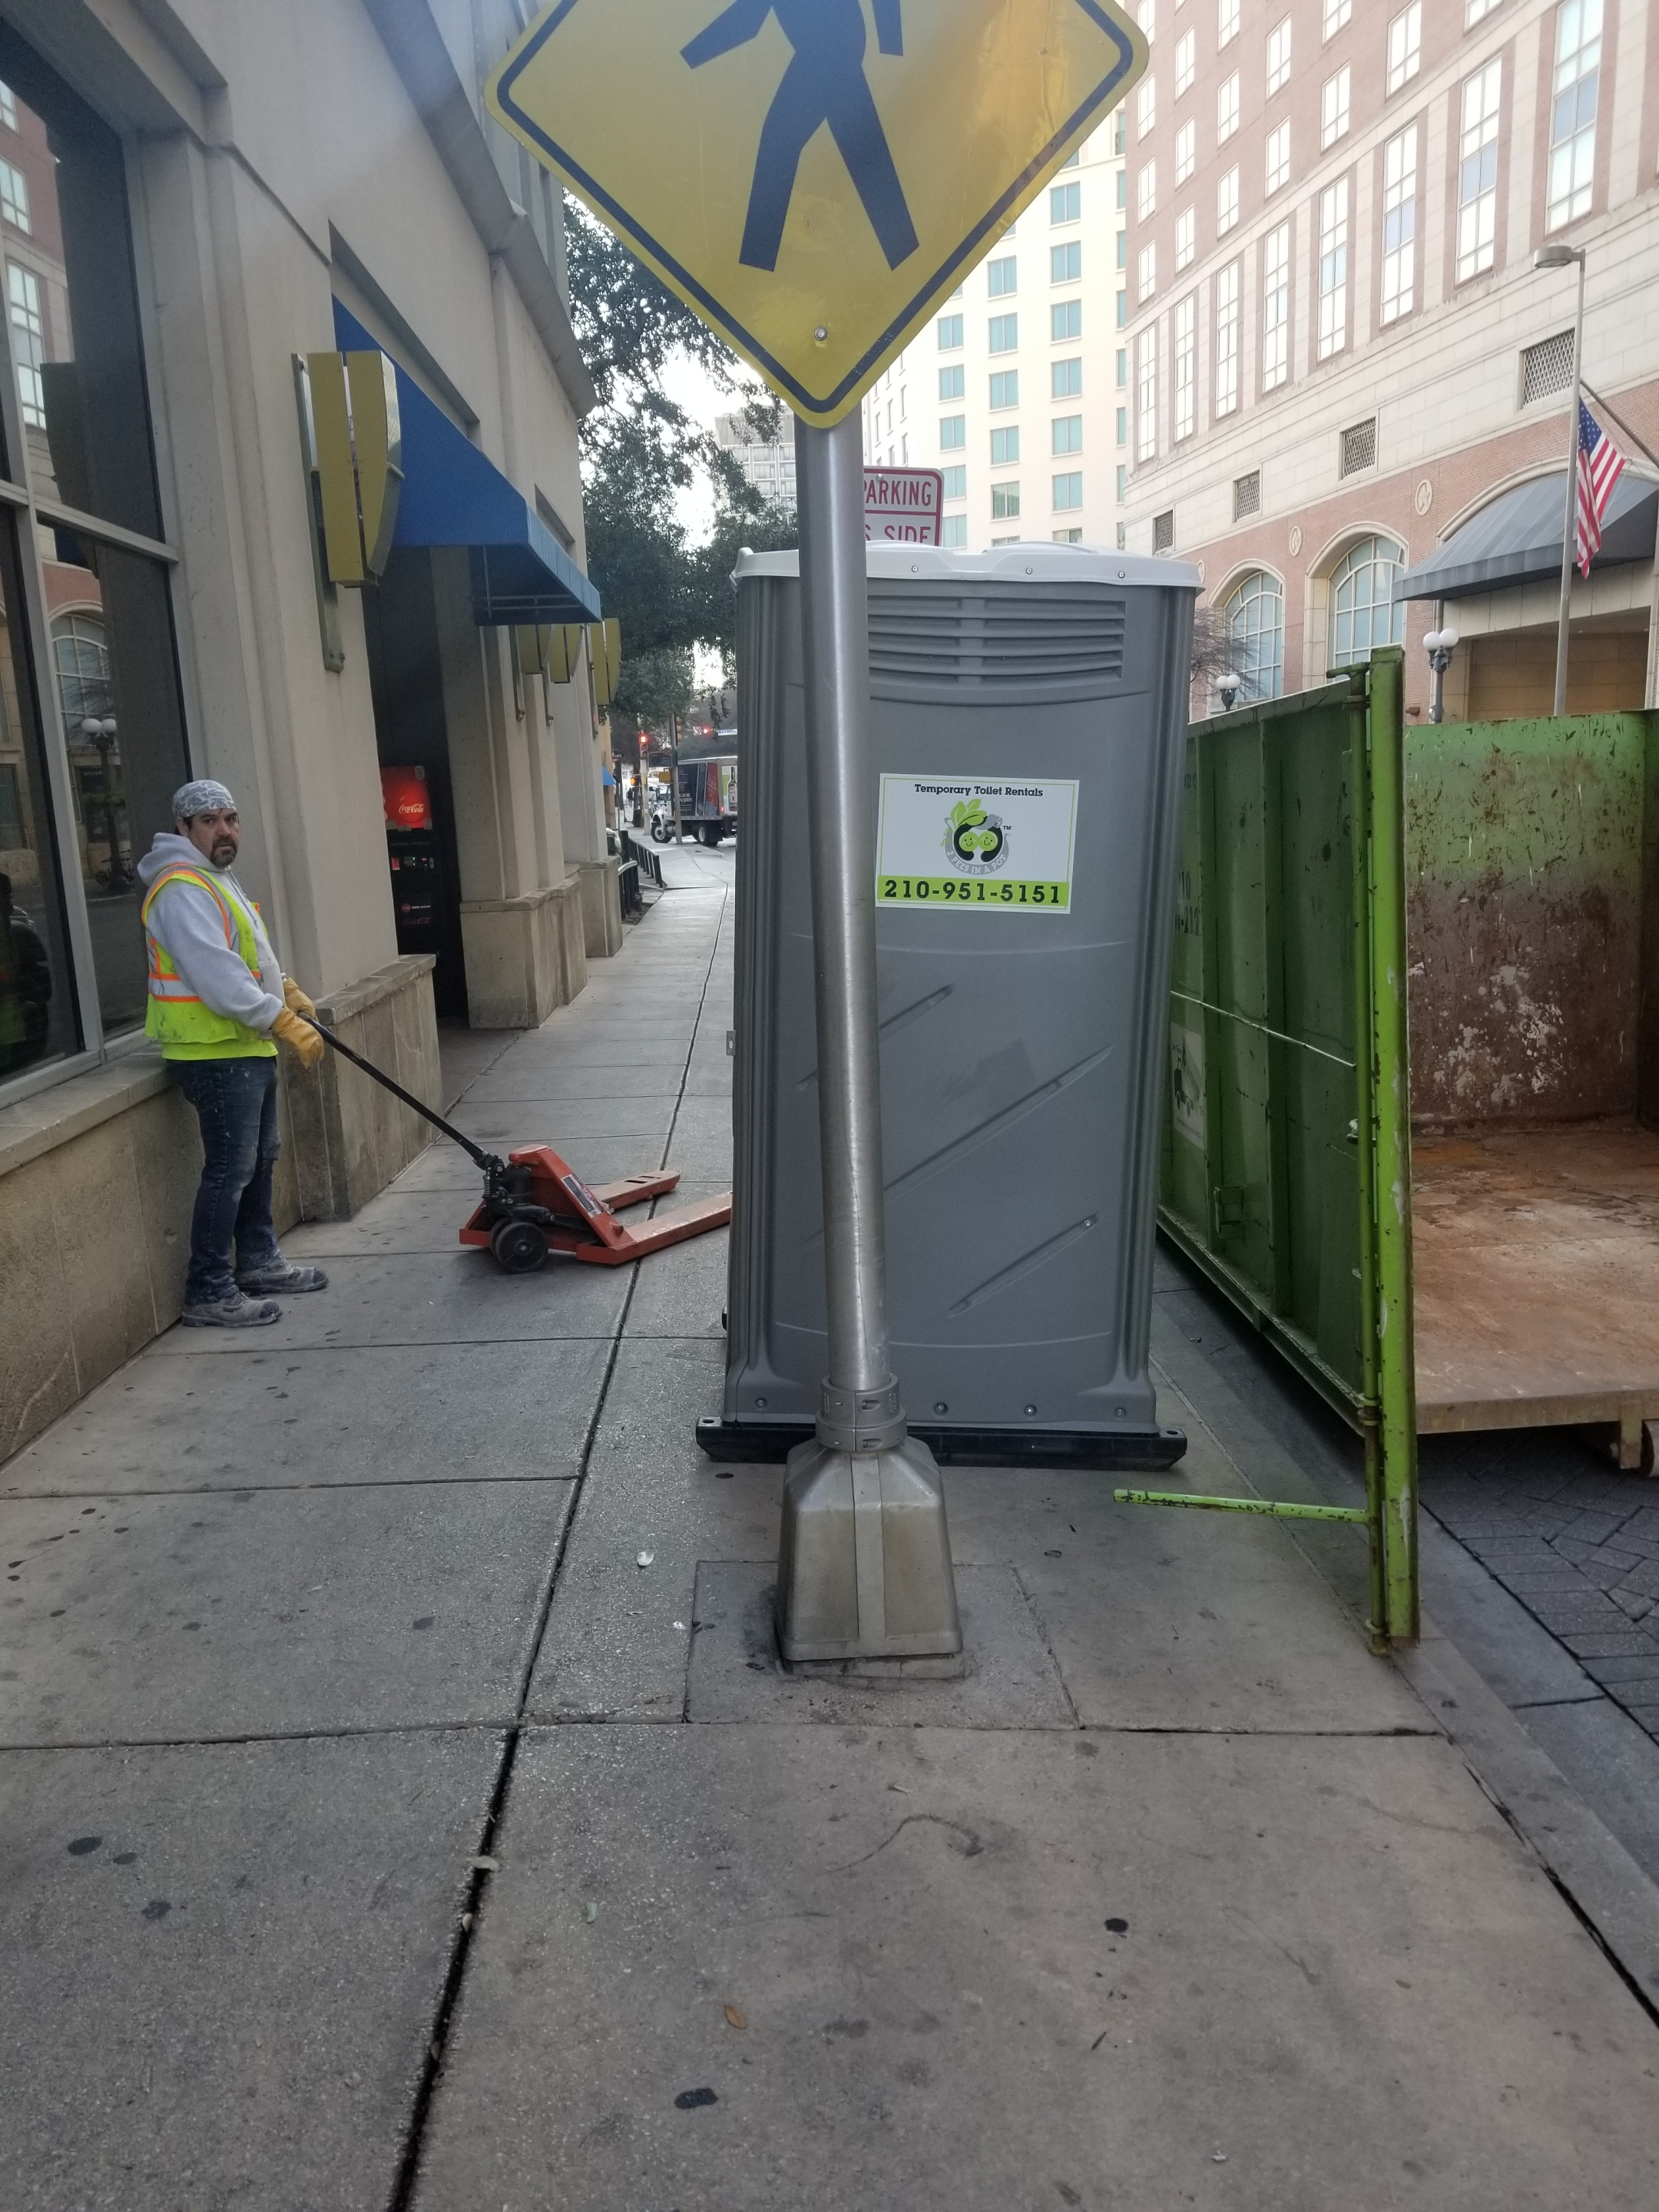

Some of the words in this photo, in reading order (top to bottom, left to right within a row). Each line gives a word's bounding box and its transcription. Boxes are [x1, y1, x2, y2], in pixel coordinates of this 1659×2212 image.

[914, 783, 971, 796] Temporary
[974, 785, 1002, 796] Toilet
[1005, 786, 1043, 797] Rentals
[950, 856, 970, 873] PEES
[971, 866, 982, 875] IN
[984, 866, 991, 874] A
[991, 853, 1007, 869] POT
[884, 879, 1059, 904] 210-951-5151
